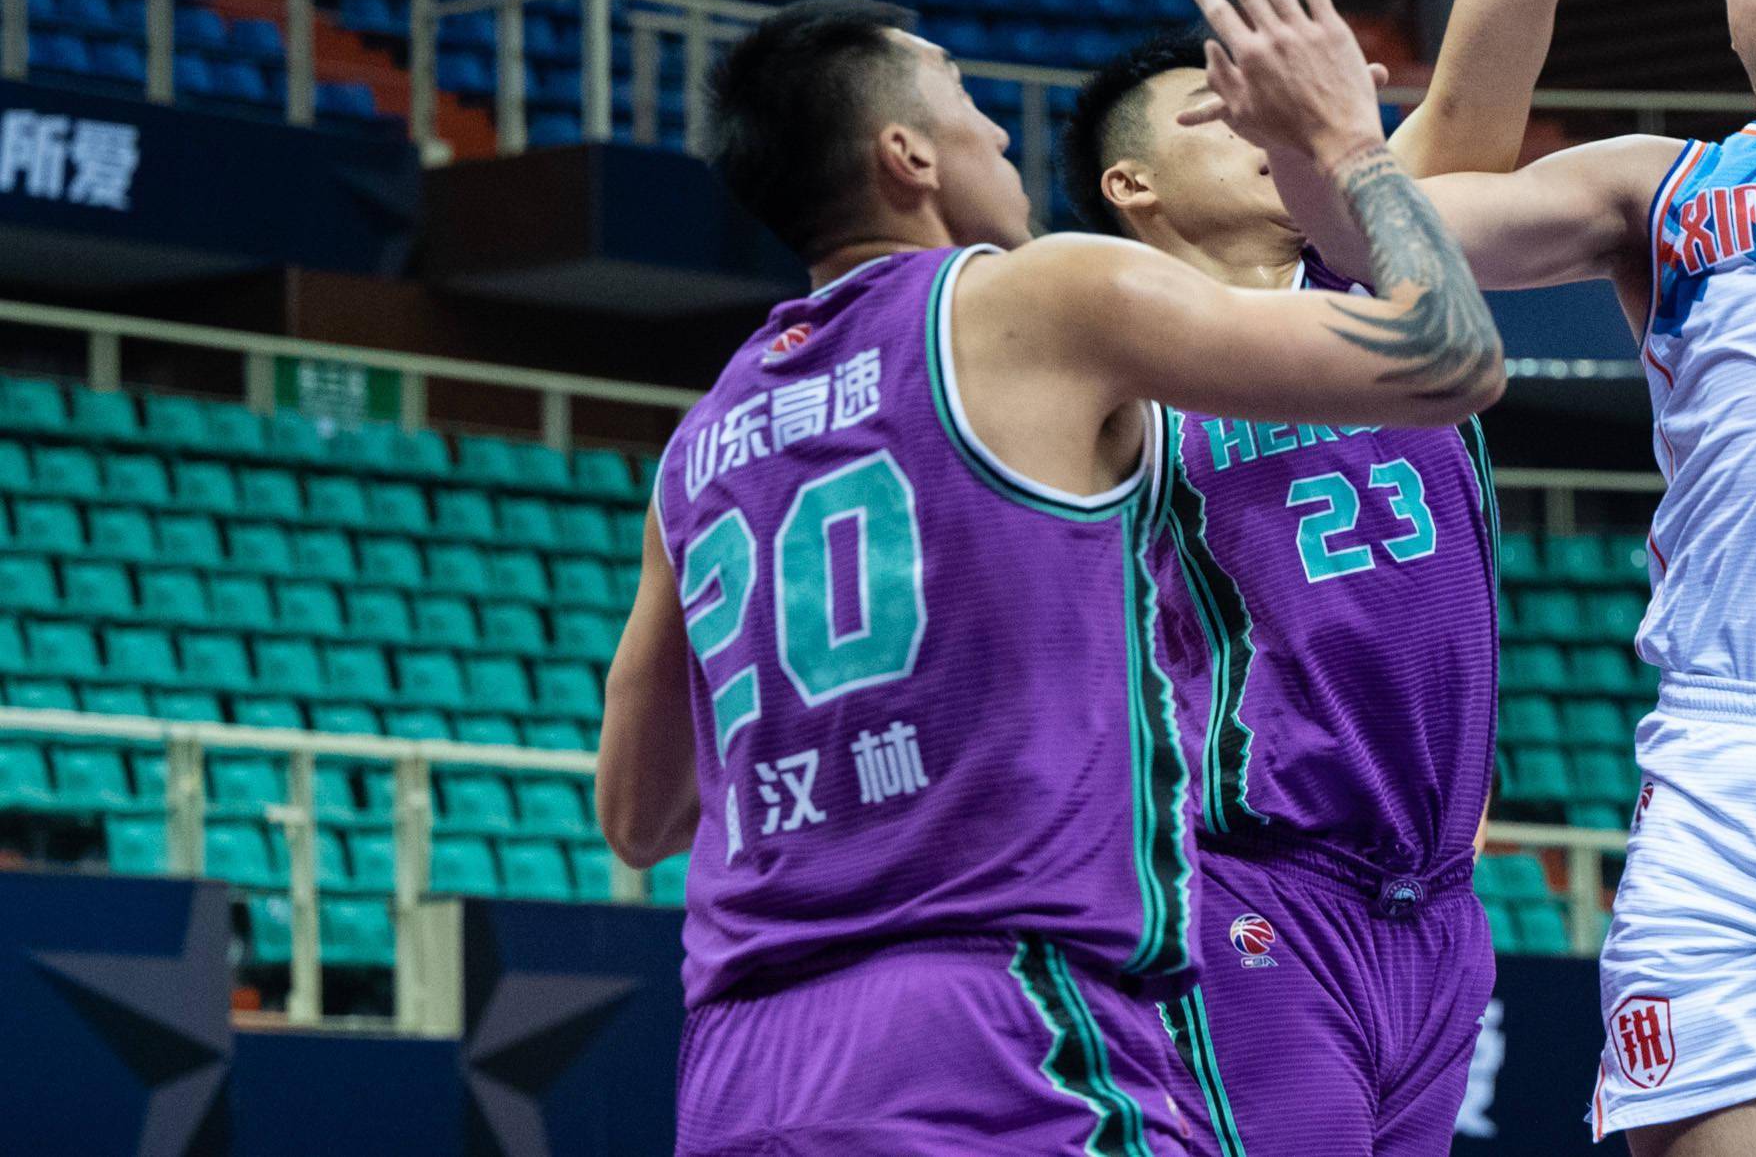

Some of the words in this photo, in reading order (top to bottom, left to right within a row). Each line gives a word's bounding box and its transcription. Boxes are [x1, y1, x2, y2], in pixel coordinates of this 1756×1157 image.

[685, 347, 881, 503] 山东高速
[1285, 457, 1437, 584] 23
[681, 448, 928, 769] 20
[726, 721, 930, 866] 汉林
